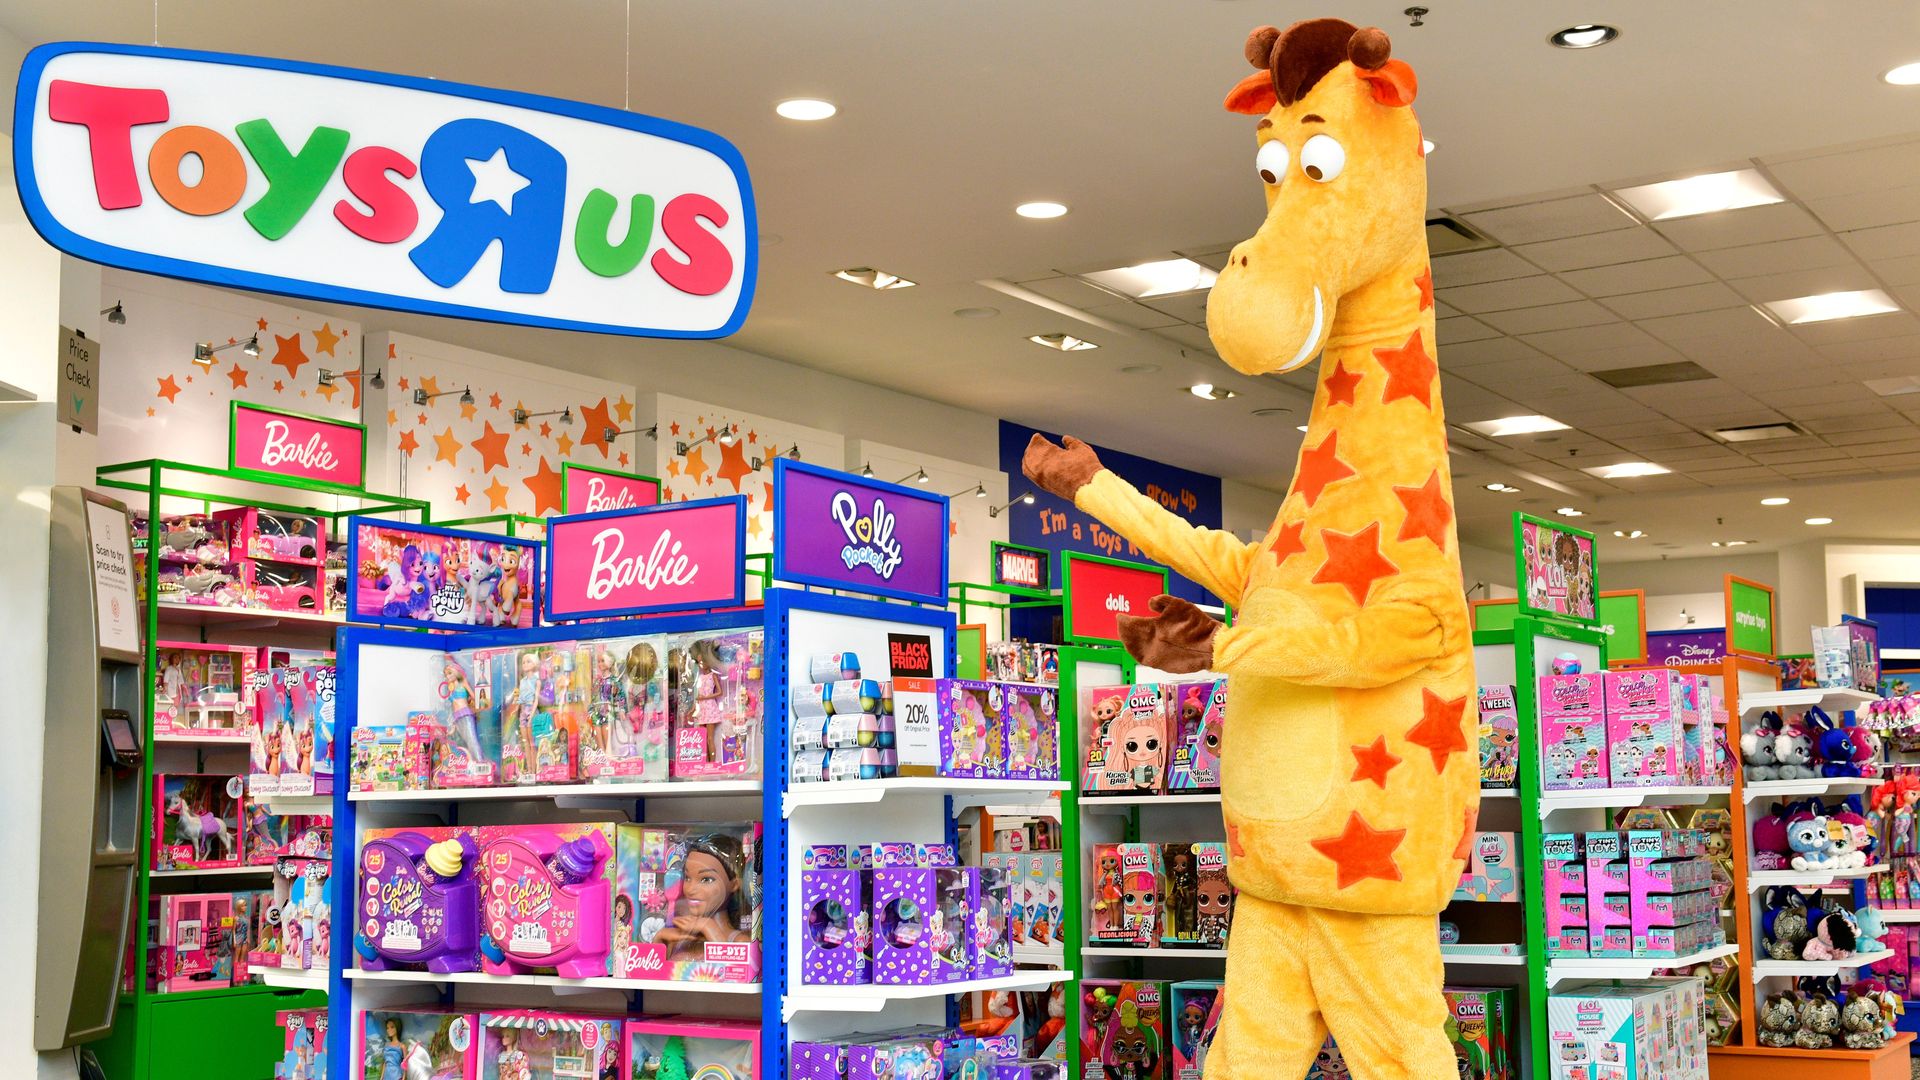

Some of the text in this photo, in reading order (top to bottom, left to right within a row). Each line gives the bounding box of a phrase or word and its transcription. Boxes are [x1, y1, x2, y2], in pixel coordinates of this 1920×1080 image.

[69, 338, 89, 362] Price
[66, 362, 91, 389] Check
[261, 420, 339, 471] Barbie
[1181, 488, 1198, 513] up
[832, 492, 902, 579] Polly
[1040, 508, 1067, 535] I'm
[1072, 522, 1082, 541] a
[1090, 524, 1122, 556] Toys
[96, 543, 125, 564] Scan to try
[96, 559, 127, 576] price check
[587, 528, 699, 600] Barbie
[1003, 553, 1038, 584] MARVEL
[1105, 593, 1130, 612] dolls
[1735, 611, 1767, 633] surprise toys
[890, 641, 929, 657] BLACK
[892, 655, 929, 670] FRIDAY
[908, 681, 921, 690] SALE
[1130, 695, 1157, 707] OMG
[1482, 699, 1512, 710] TWEENS
[905, 704, 929, 724] 20%
[910, 725, 923, 733] Original
[679, 730, 703, 746] Barbie
[1090, 751, 1102, 762] 20
[1176, 749, 1188, 760] 20
[173, 848, 192, 859] Barbie
[1545, 845, 1574, 855] TOYS
[1588, 843, 1617, 853] TOYS
[1631, 842, 1661, 852] TOYS
[369, 855, 381, 865] 25
[495, 854, 507, 865] 25
[1125, 854, 1148, 865] OMG
[1199, 854, 1223, 865] OMG
[381, 878, 416, 904] Color
[390, 882, 423, 916] Reveal
[508, 878, 545, 905] Color
[518, 882, 552, 918] Reveal
[625, 945, 664, 972] Barbie
[707, 945, 747, 956] TIE-DYE
[1138, 992, 1160, 1002] OMG
[1458, 1005, 1485, 1015] OMG
[585, 1024, 594, 1033] 25
